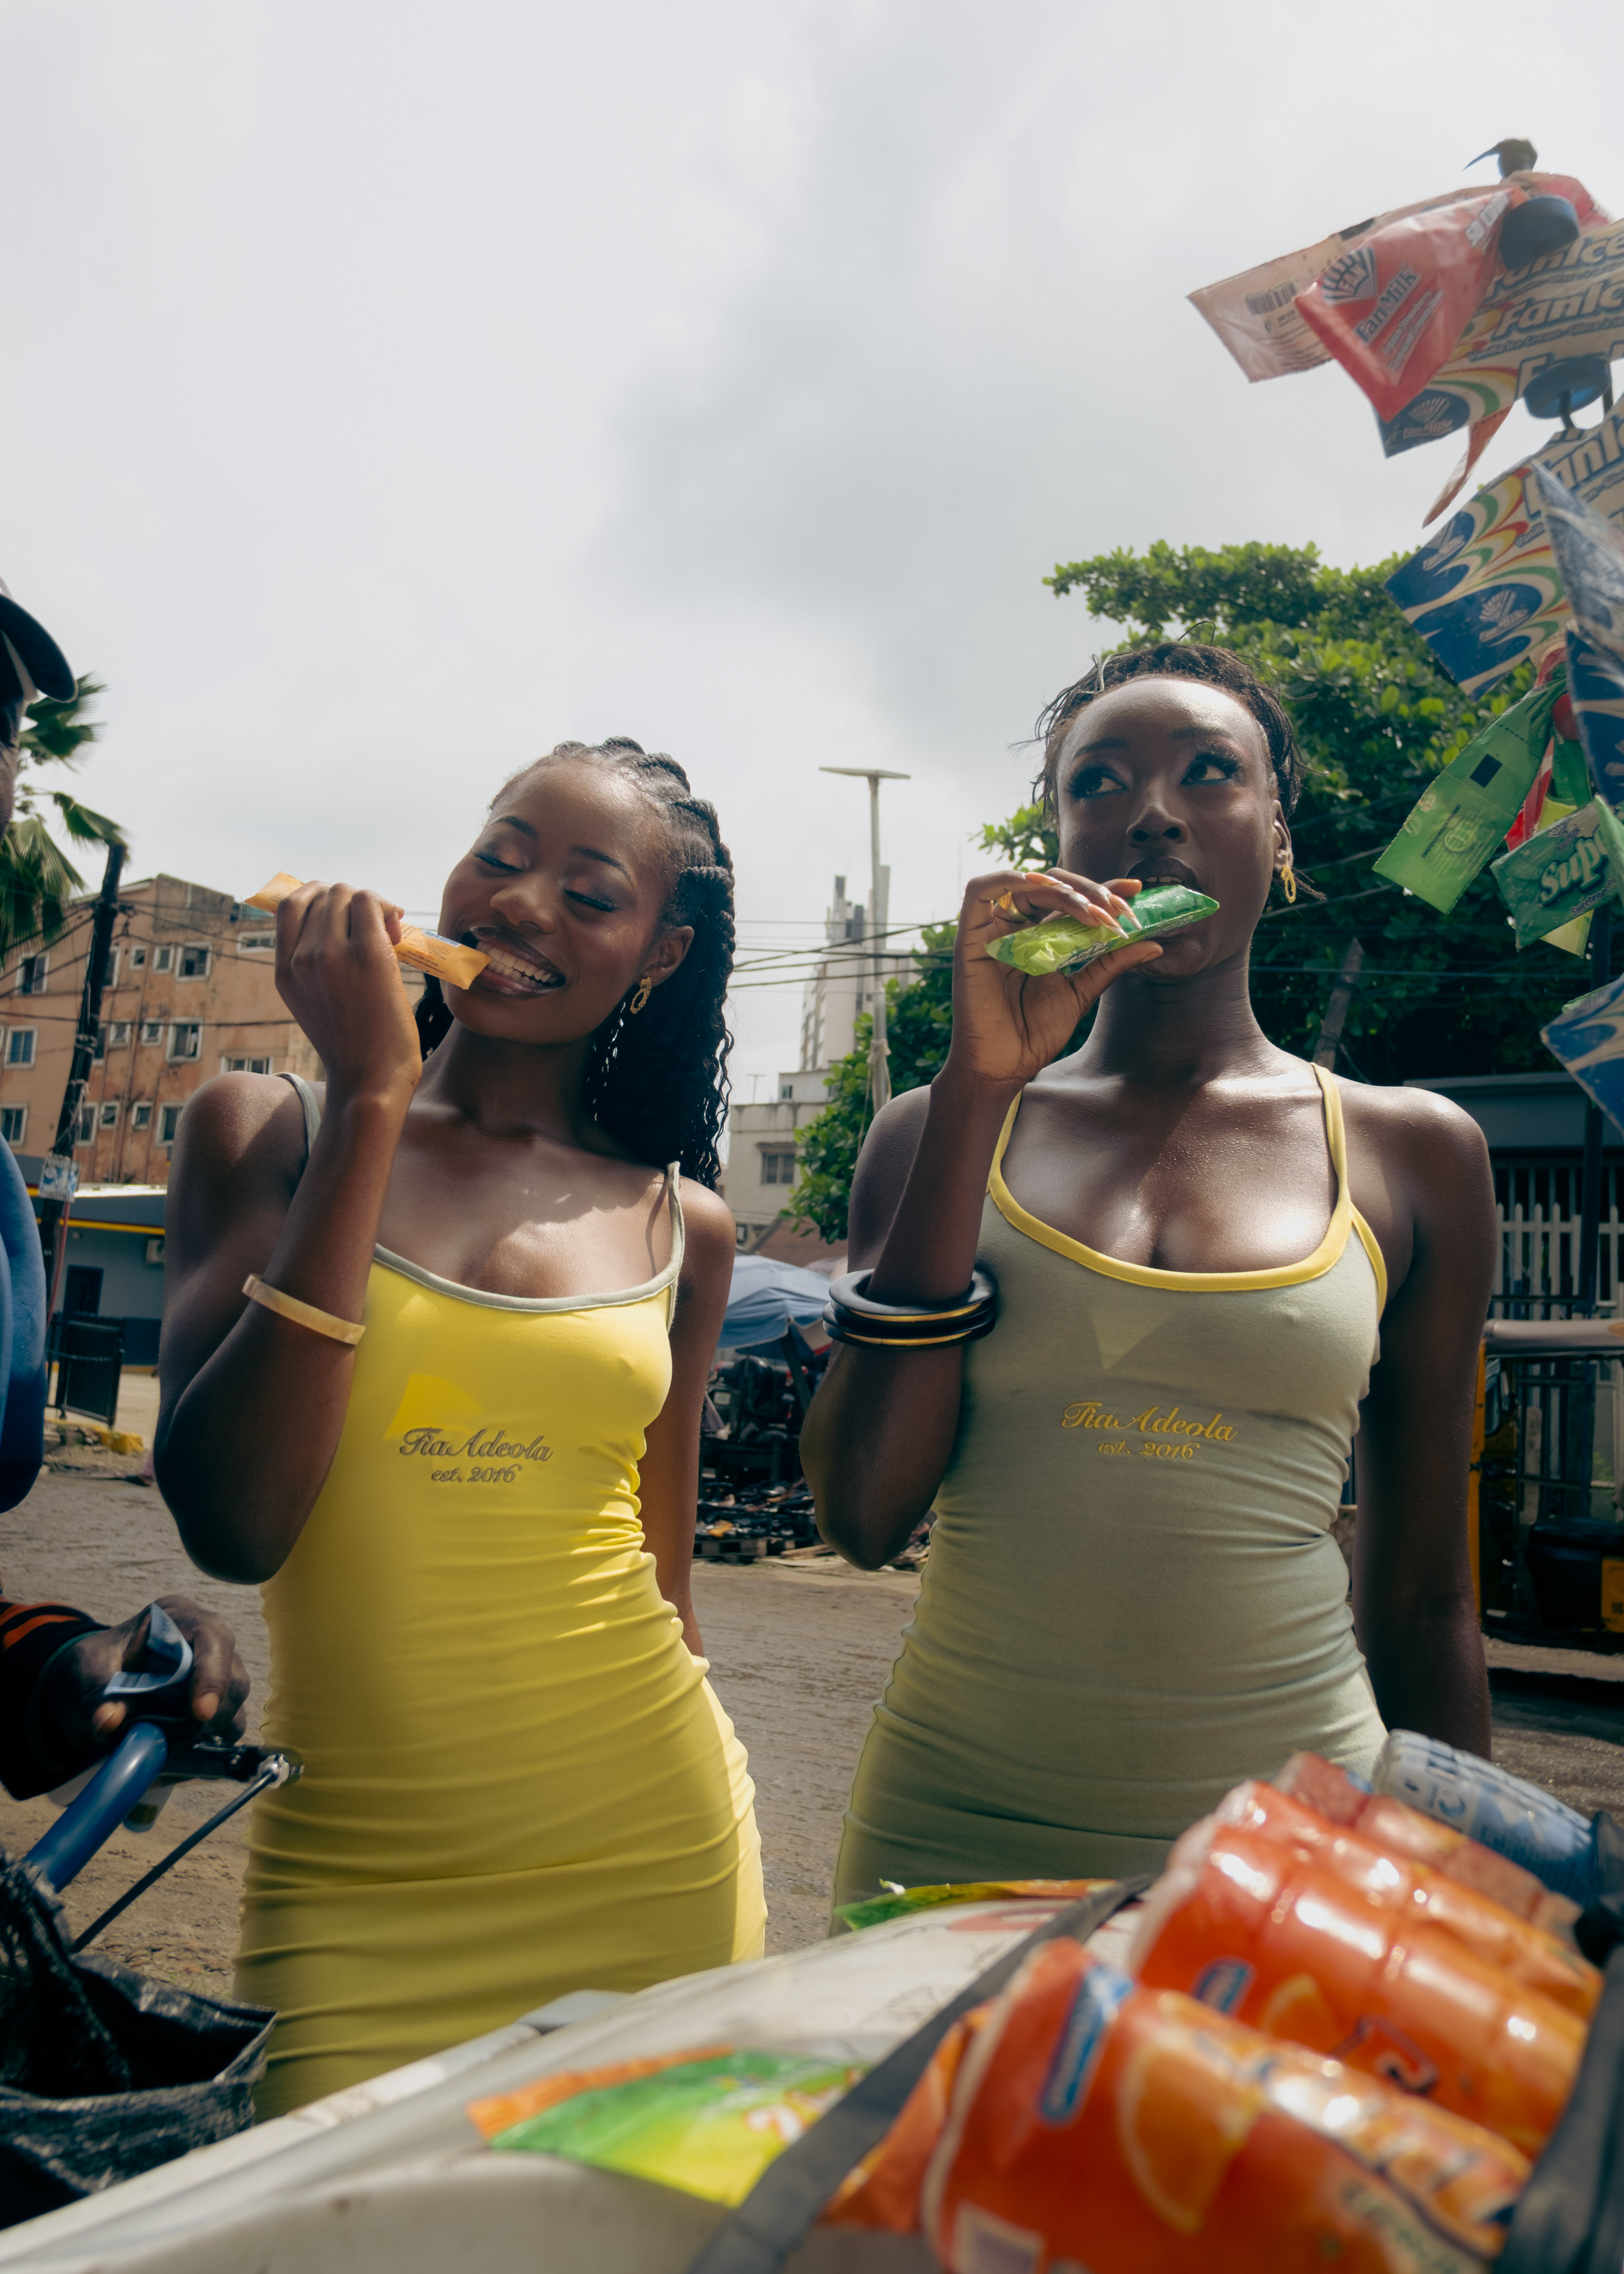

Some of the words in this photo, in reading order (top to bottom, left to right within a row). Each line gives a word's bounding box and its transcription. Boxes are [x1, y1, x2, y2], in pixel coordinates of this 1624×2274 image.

[1338, 262, 1368, 295] FAN
[1353, 269, 1421, 347] FanMilk
[1381, 327, 1403, 356] Frozen
[1387, 333, 1416, 373] Flavoured
[1061, 1401, 1116, 1429] Tia
[1113, 1406, 1238, 1442] Adeola
[400, 1427, 451, 1456] Tia
[446, 1429, 554, 1461] Adeola
[1098, 1441, 1131, 1456] est.
[1139, 1442, 1200, 1460] 2016
[431, 1467, 462, 1483] est.
[467, 1464, 522, 1483] 2016
